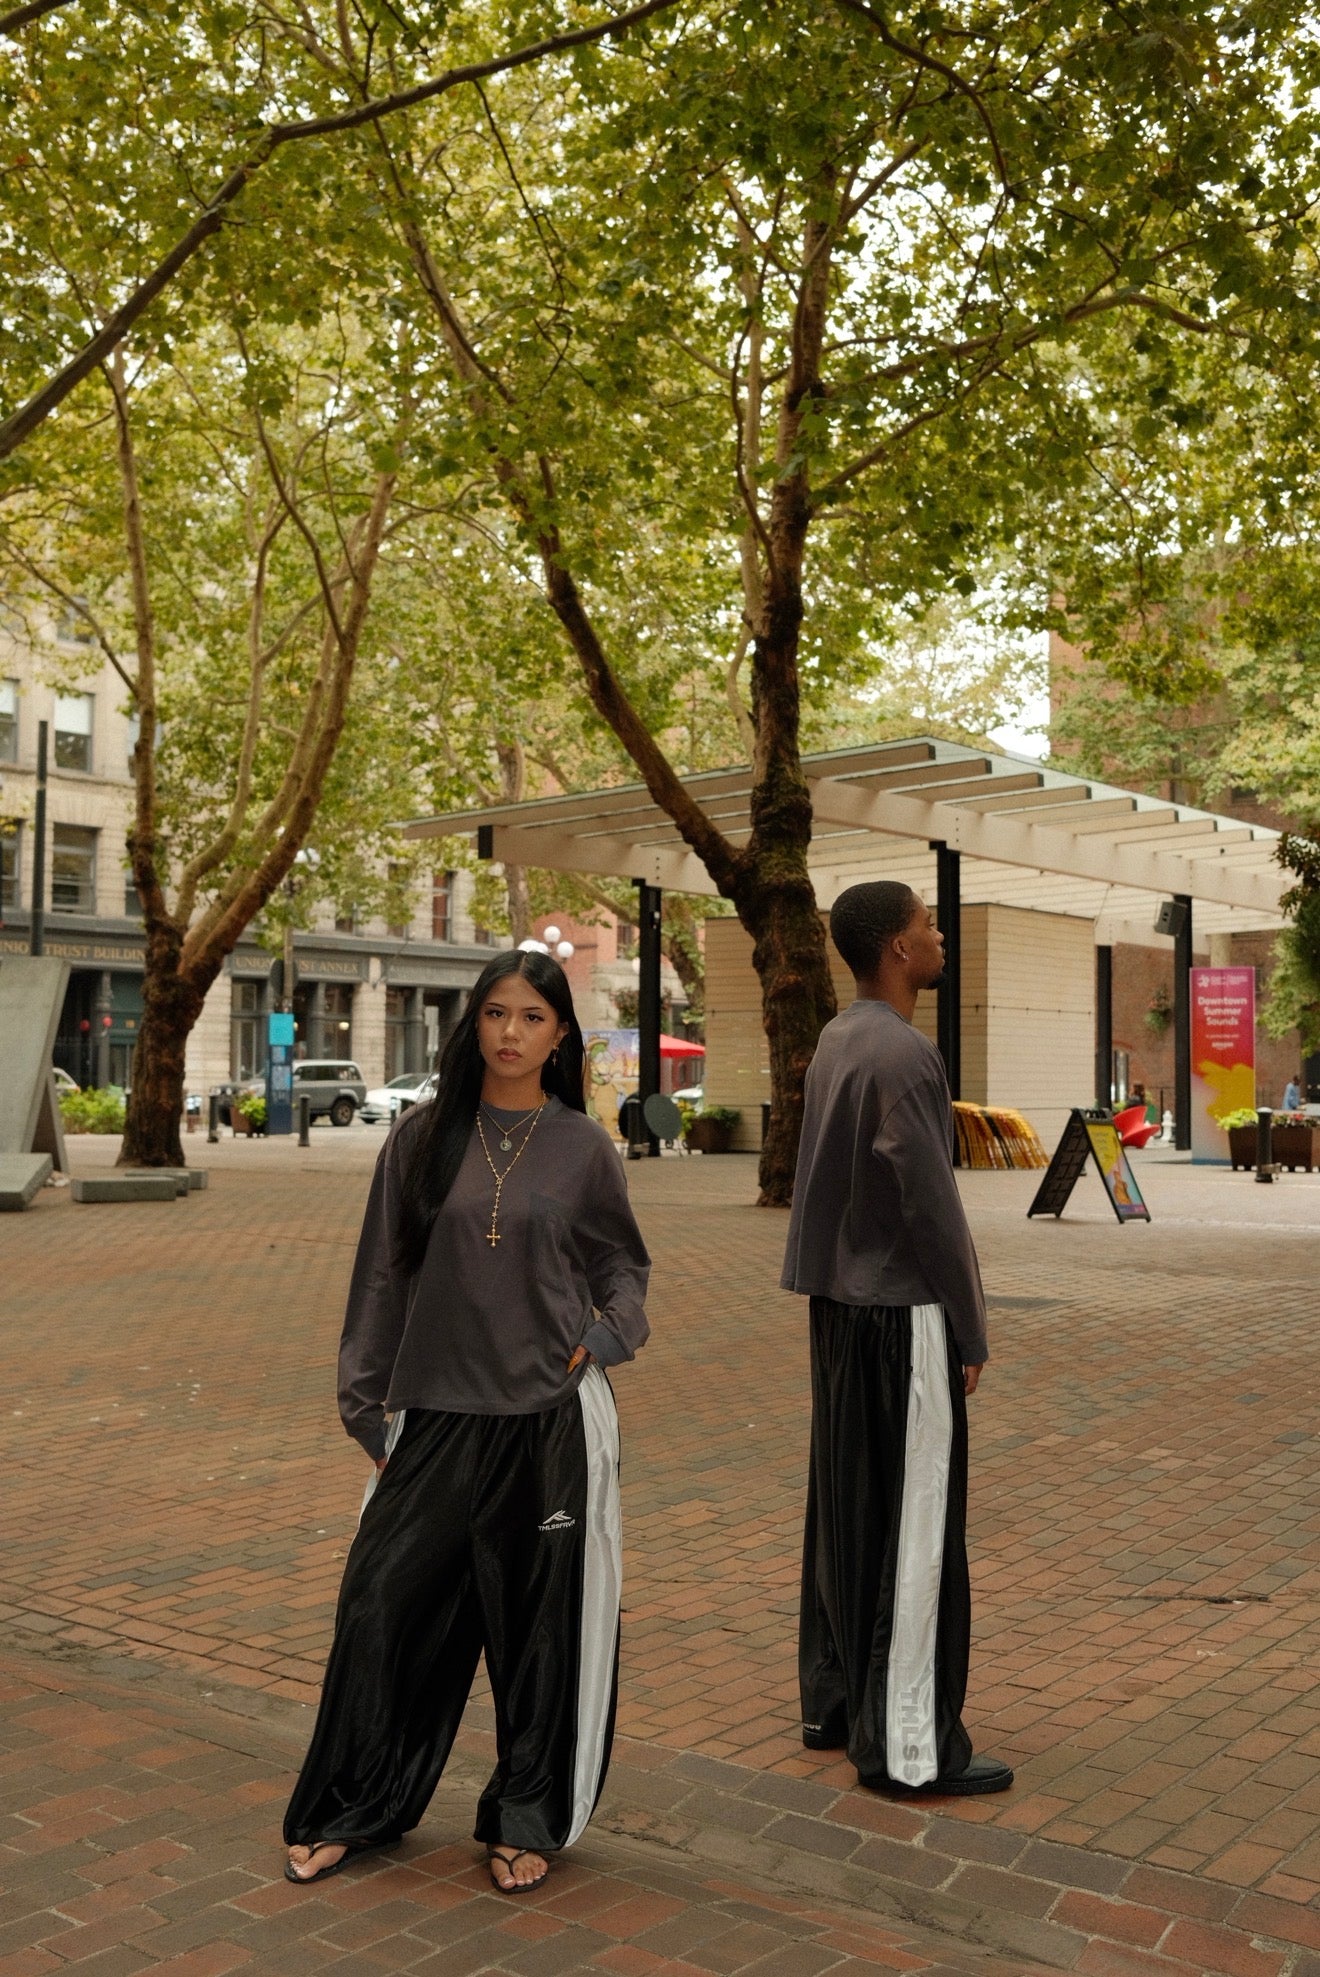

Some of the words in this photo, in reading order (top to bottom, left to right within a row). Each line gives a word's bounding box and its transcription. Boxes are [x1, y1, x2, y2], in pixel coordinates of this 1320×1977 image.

[44, 943, 90, 957] TRUST
[94, 946, 146, 960] BUILDIN
[319, 961, 358, 974] ANNEX
[1197, 996, 1248, 1006] Downtown
[1203, 1006, 1242, 1016] Summer
[1206, 1016, 1239, 1026] Sounds
[900, 1687, 920, 1780] TMLSS
